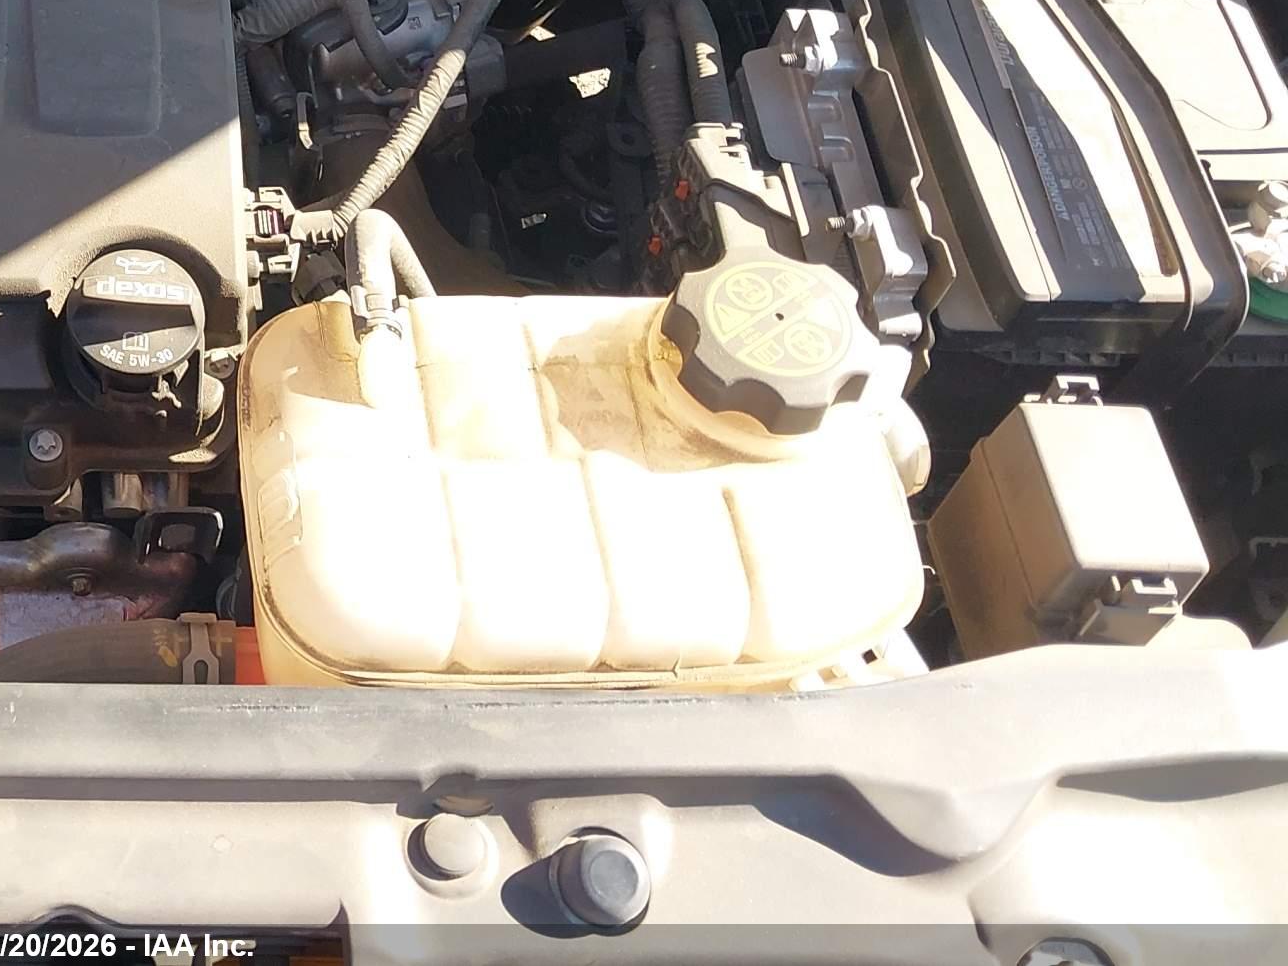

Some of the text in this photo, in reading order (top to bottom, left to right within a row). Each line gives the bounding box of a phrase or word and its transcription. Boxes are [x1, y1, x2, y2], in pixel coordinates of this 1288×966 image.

[96, 277, 184, 301] dexos
[99, 344, 174, 368] SAE 5W-30
